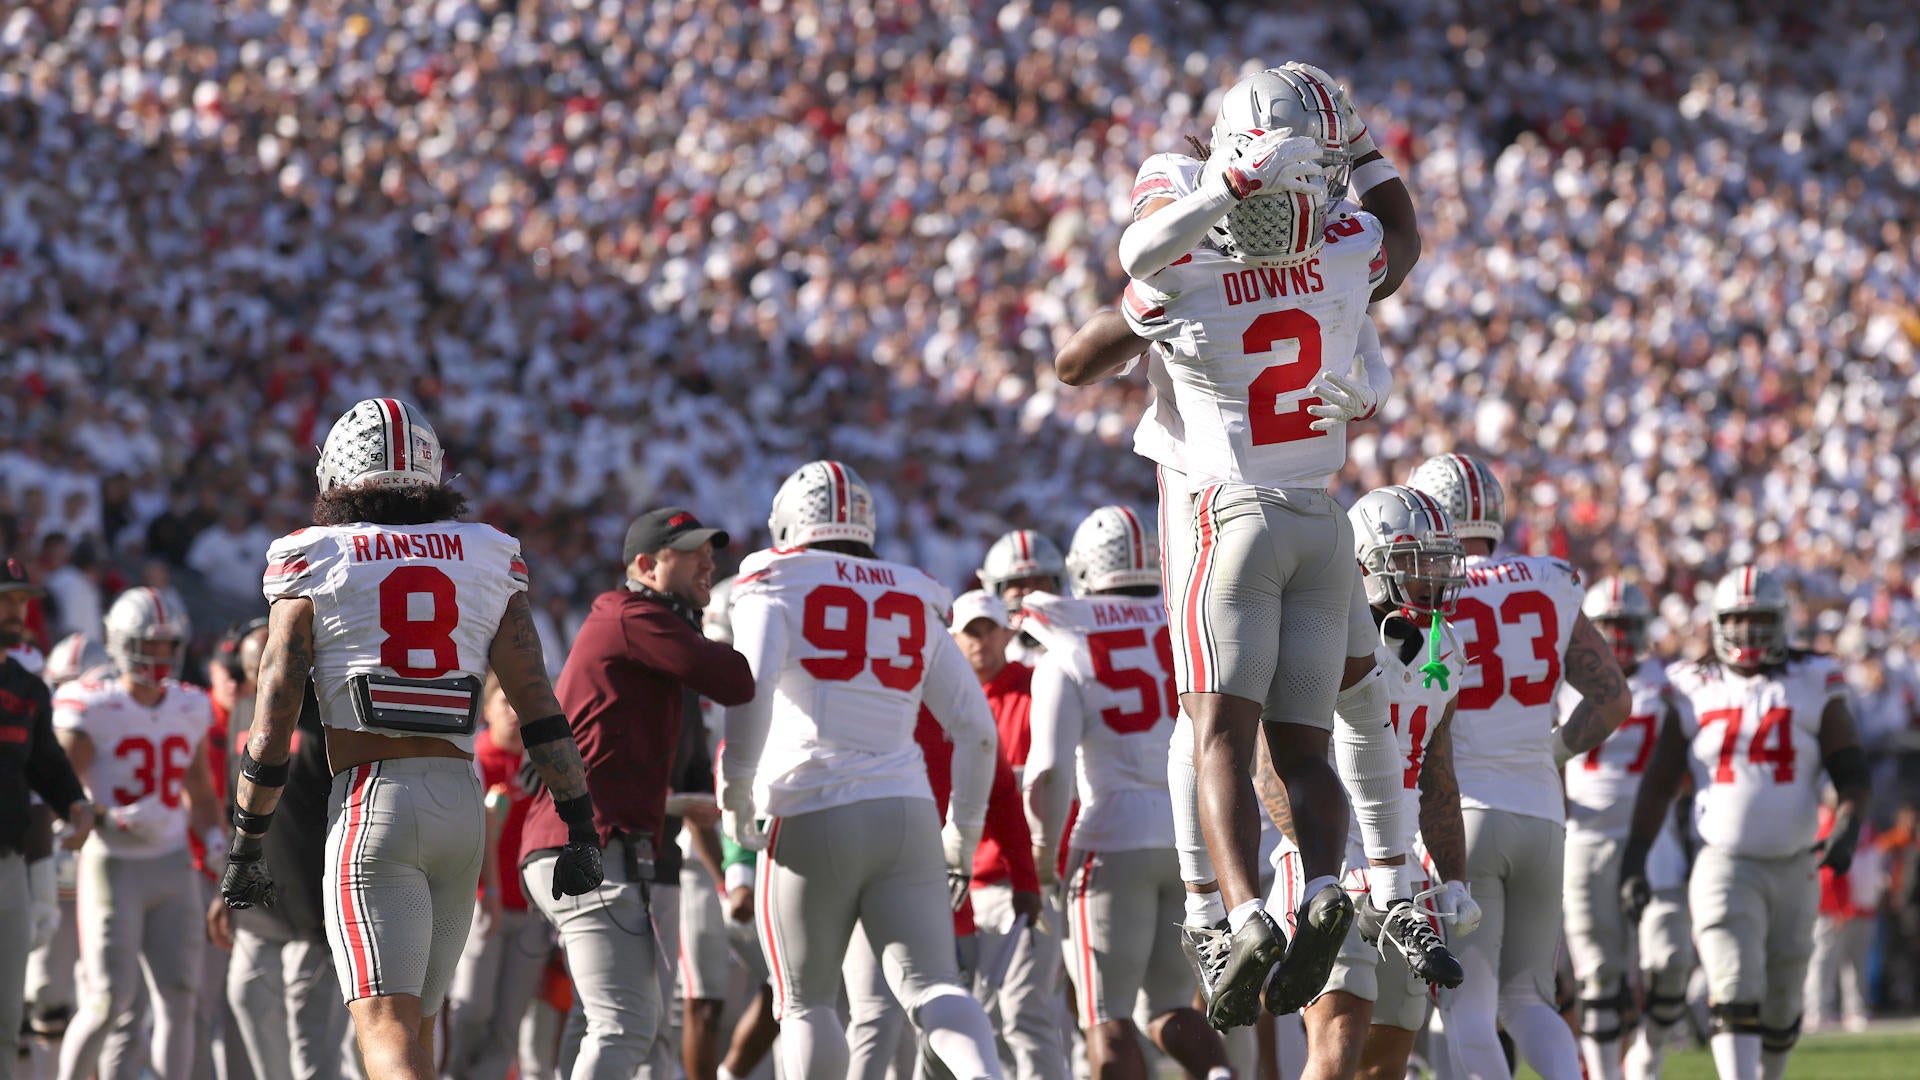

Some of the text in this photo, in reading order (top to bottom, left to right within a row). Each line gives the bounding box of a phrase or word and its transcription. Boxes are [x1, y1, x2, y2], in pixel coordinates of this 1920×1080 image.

[1223, 258, 1324, 306] DOWNS
[1242, 308, 1328, 446] 2
[353, 533, 464, 562] RANSOM
[835, 560, 896, 586] KANU
[379, 565, 460, 678] 8
[800, 584, 926, 692] 93
[1091, 603, 1166, 626] HAMILT
[113, 733, 190, 808] 36
[1698, 706, 1794, 784] 74
